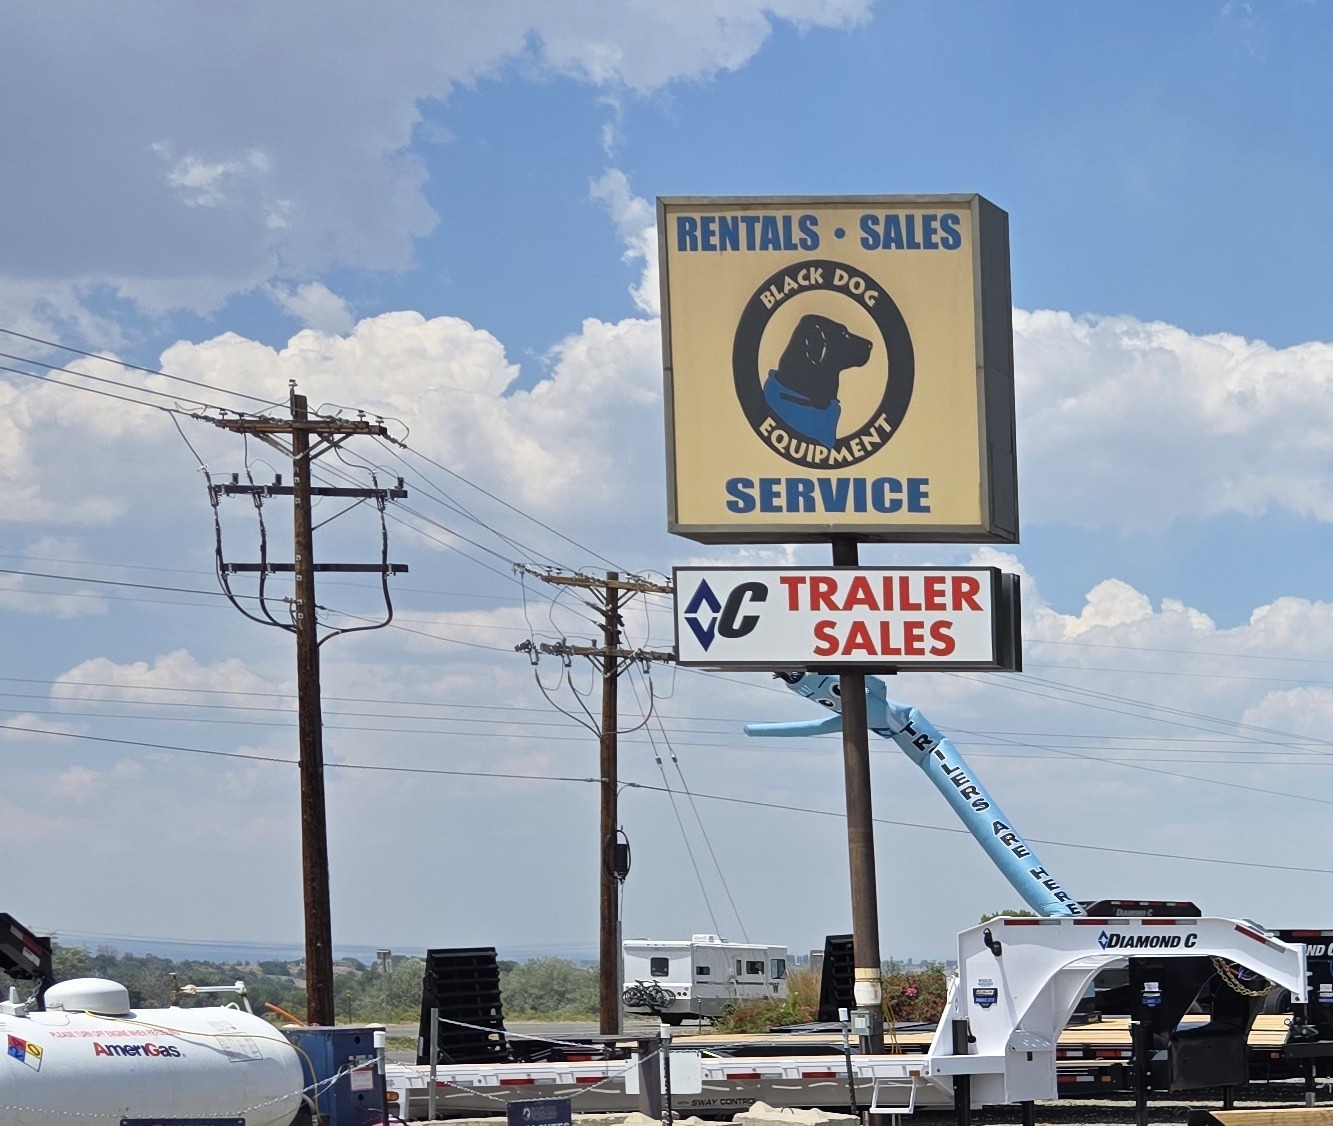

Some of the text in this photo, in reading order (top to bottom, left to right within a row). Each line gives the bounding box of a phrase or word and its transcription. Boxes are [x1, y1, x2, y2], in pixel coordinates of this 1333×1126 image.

[677, 213, 962, 252] RENTALS SALES
[759, 267, 880, 310] BLACK DOG
[759, 413, 893, 465] EQUIPMENT
[725, 477, 931, 514] SERVICE
[779, 575, 984, 612] TRAILER
[813, 619, 956, 657] SALES
[899, 720, 1081, 915] TRILERS ARE HERE
[1106, 933, 1198, 948] DIAMOND C
[93, 1042, 181, 1058] AmeriGas
